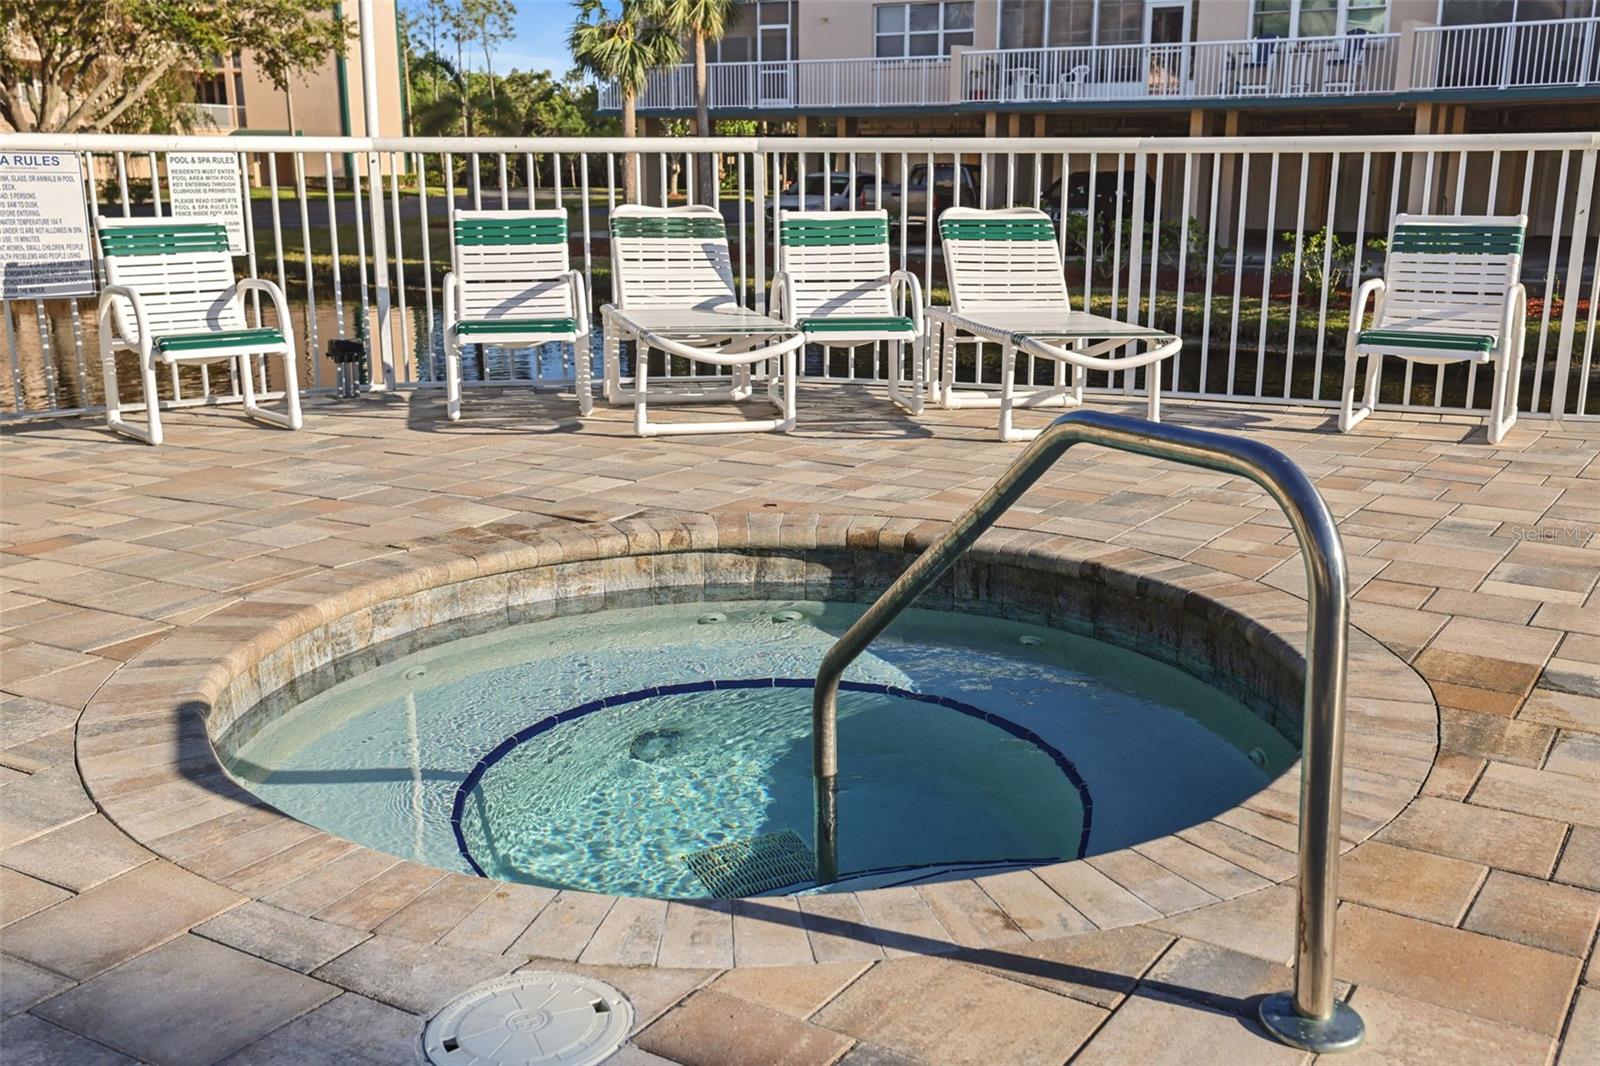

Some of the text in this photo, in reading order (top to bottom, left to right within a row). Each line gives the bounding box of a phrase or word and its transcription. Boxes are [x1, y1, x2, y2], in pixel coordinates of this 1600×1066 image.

[14, 155, 60, 166] RULES
[170, 156, 189, 164] POOL
[191, 156, 196, 164] &
